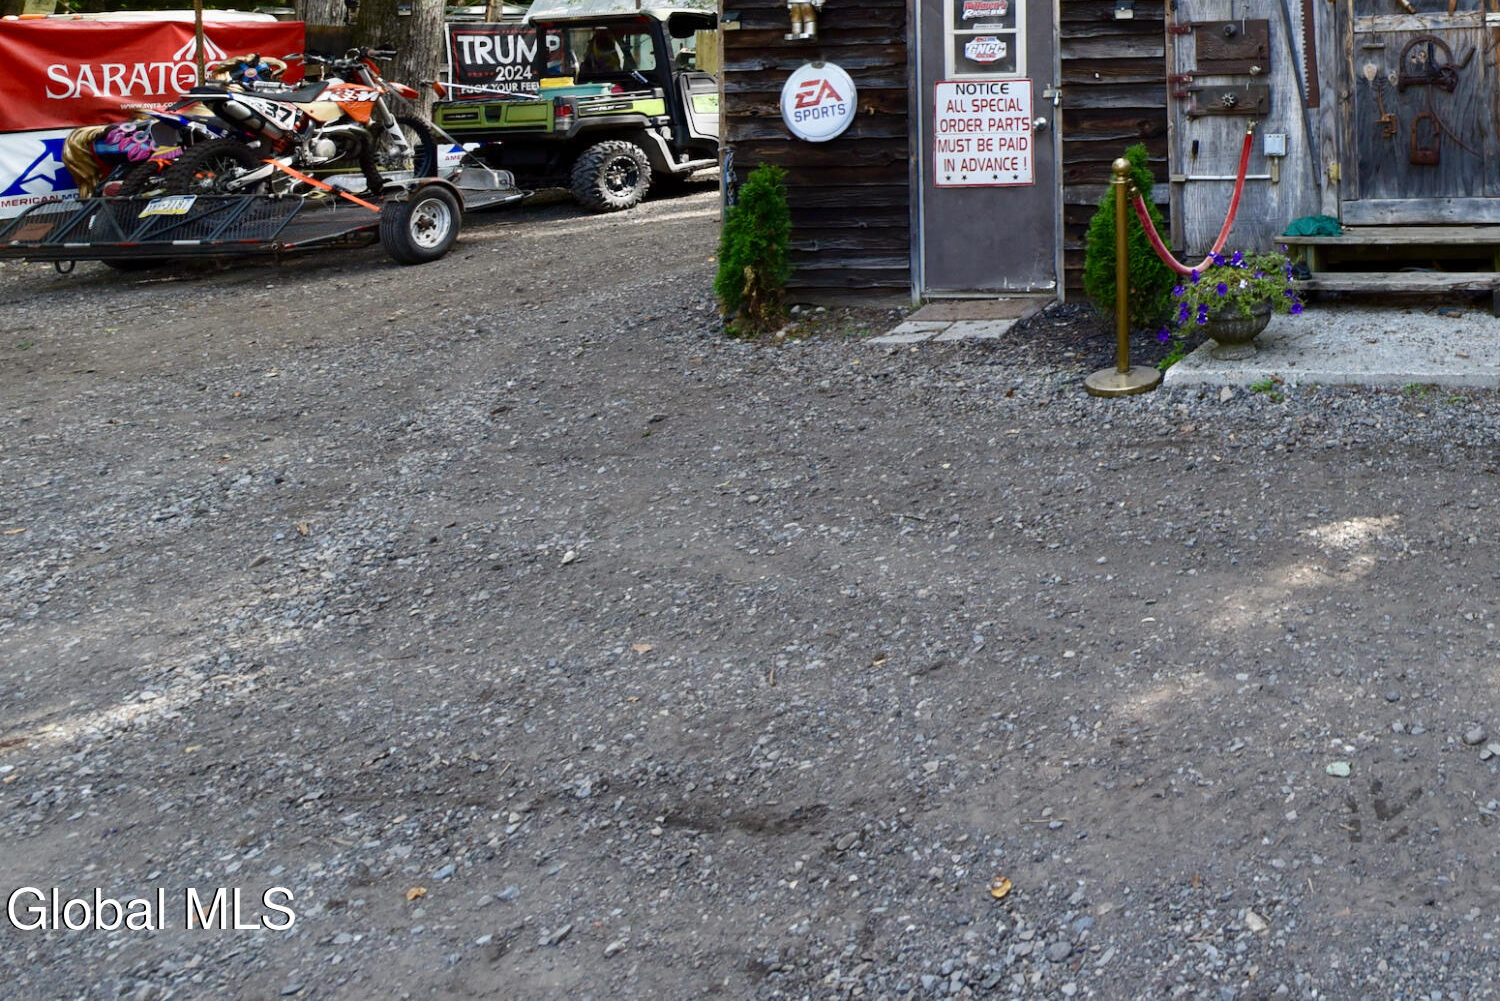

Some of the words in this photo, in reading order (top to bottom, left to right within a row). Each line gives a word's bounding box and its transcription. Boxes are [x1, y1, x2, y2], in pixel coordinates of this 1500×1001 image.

[970, 43, 1004, 55] GNCC
[46, 61, 222, 99] SARATO
[495, 65, 532, 81] 2024
[491, 82, 518, 92] YOUR
[794, 79, 843, 109] EA
[956, 83, 1009, 95] NOTICE
[265, 101, 293, 122] 37
[794, 103, 846, 122] SPORTS
[946, 99, 966, 113] ALL
[972, 98, 1023, 113] SPECIAL
[940, 118, 983, 132] ORDER
[988, 117, 1030, 131] PARTS
[937, 138, 972, 153] MUST
[977, 138, 993, 152] BE
[999, 137, 1028, 151] PAID
[944, 158, 955, 172] IN
[960, 157, 1018, 172] ADVANCE
[0, 195, 59, 208] MERICAN
